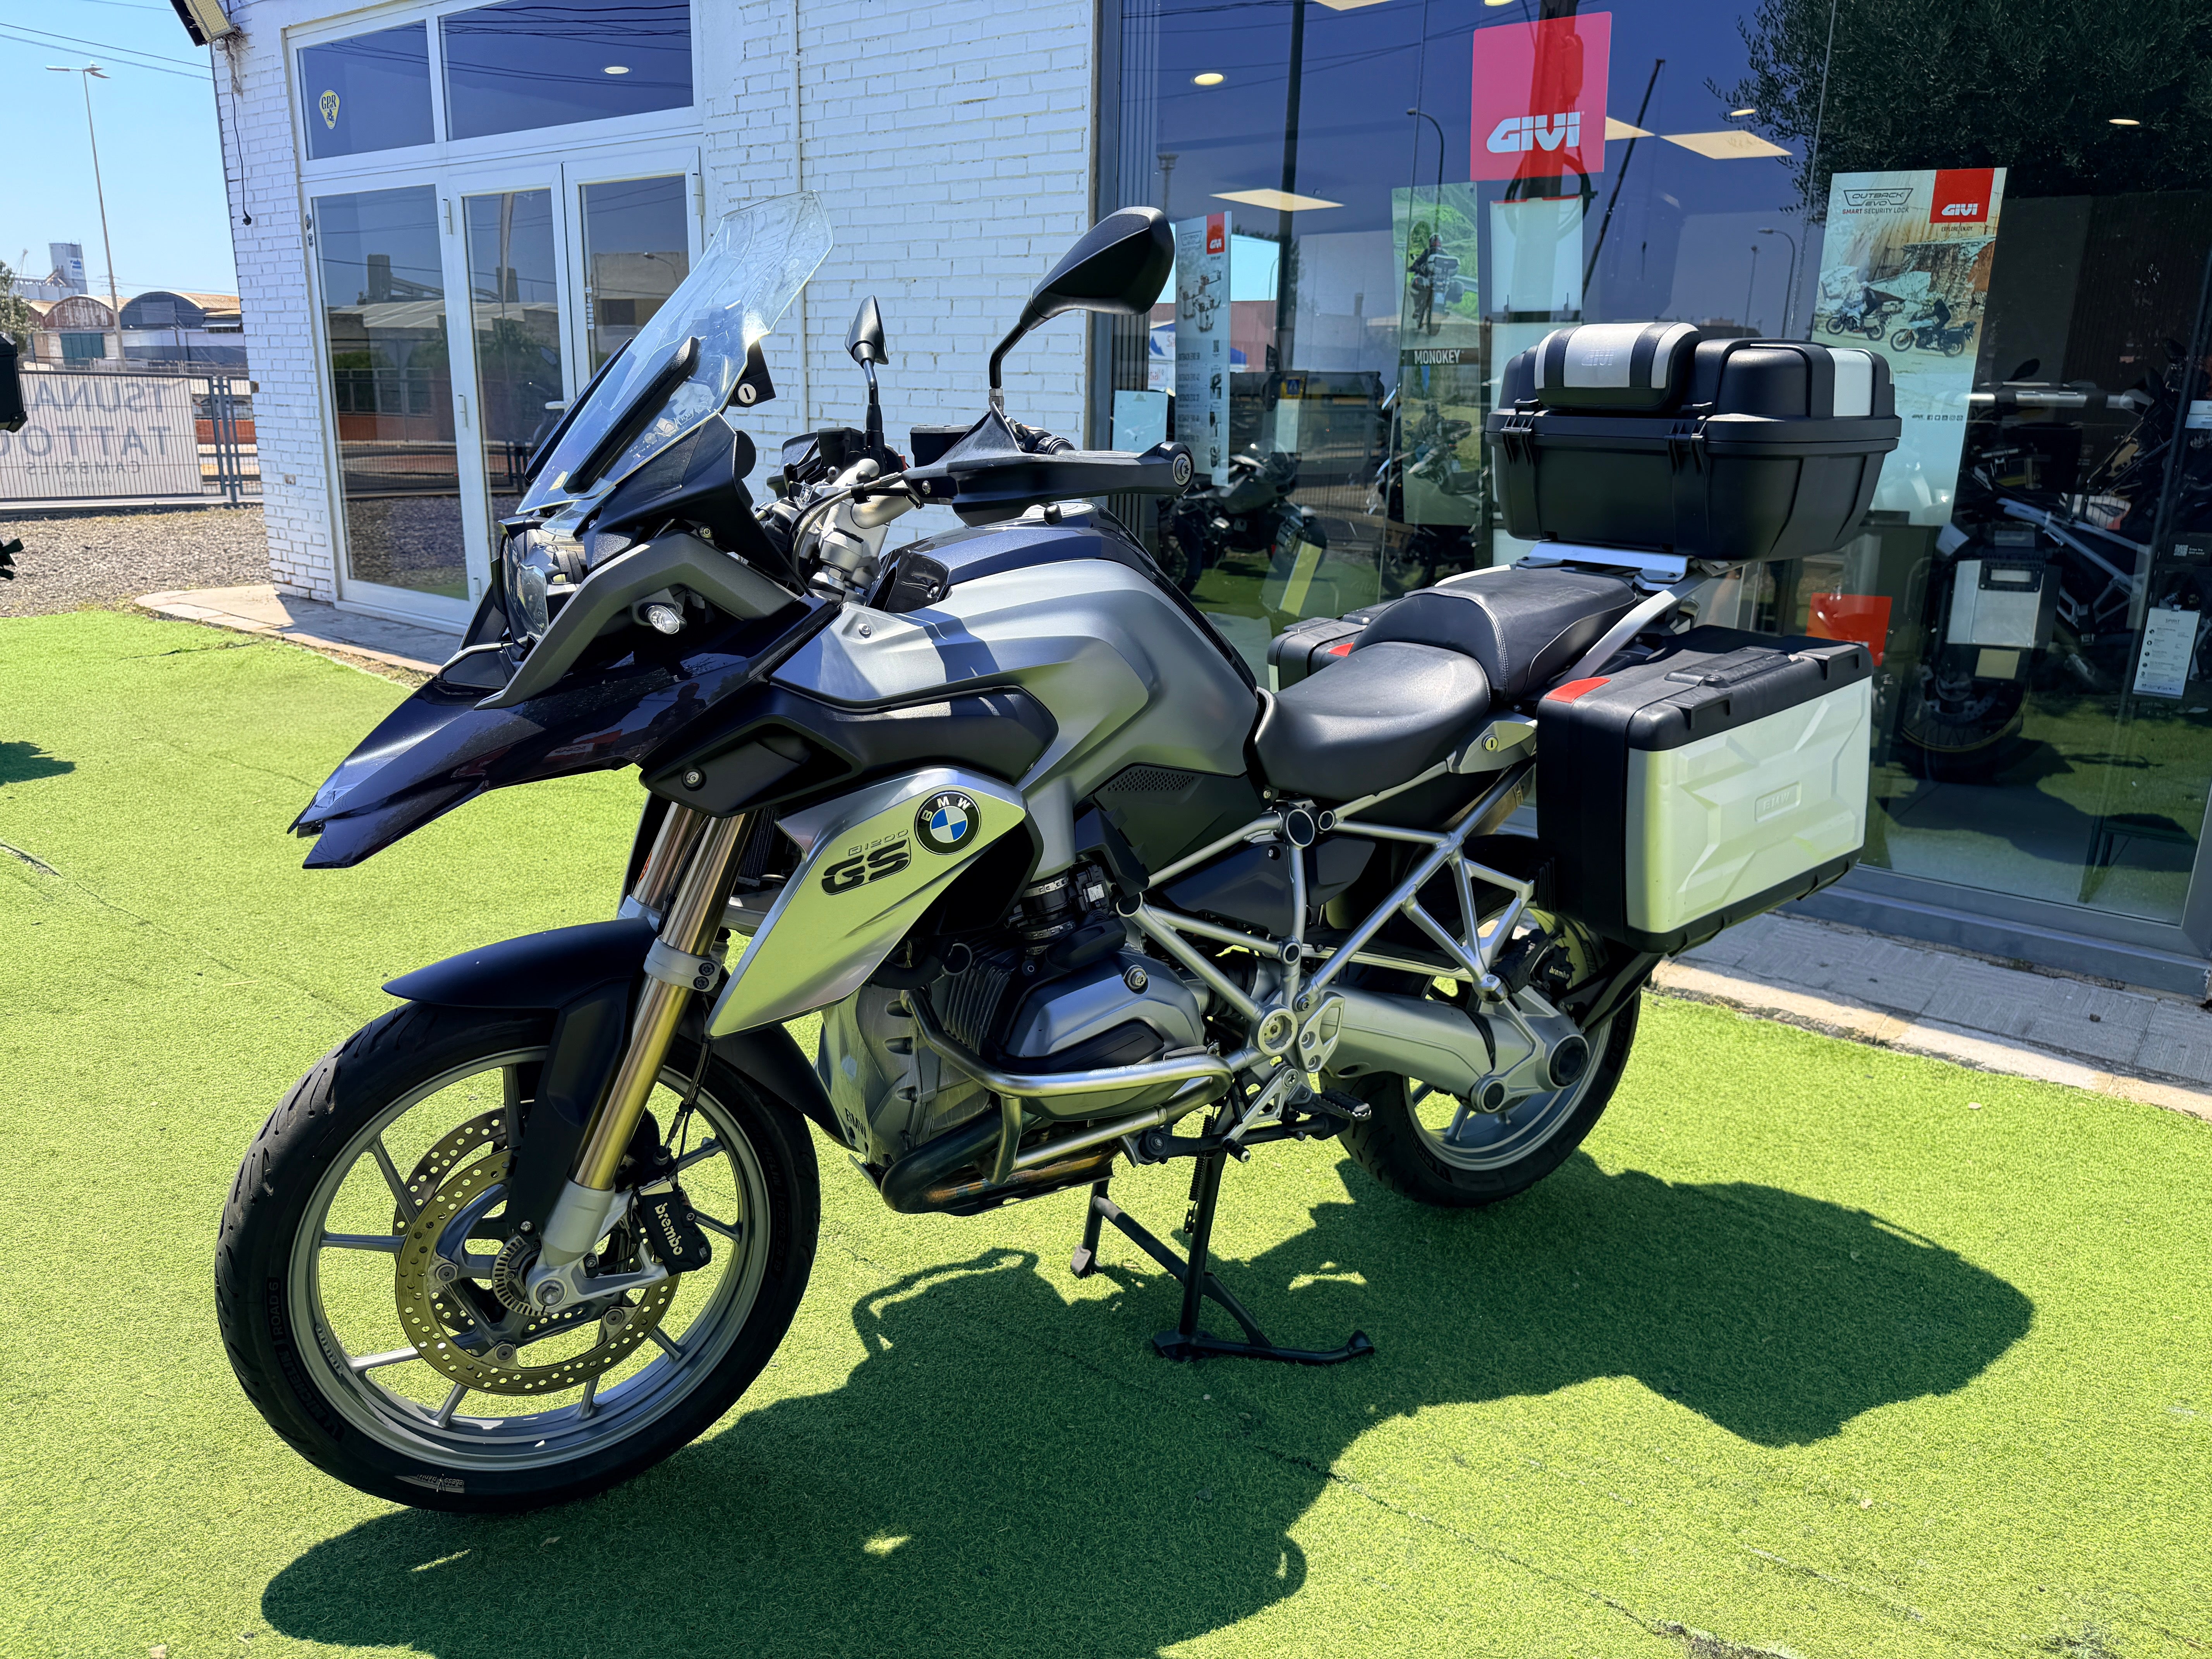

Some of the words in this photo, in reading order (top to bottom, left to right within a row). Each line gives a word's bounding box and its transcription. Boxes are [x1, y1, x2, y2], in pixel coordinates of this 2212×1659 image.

[321, 94, 336, 110] GPR
[1486, 112, 1581, 153] GIVI
[1941, 203, 1978, 216] GIVI
[1414, 349, 1460, 365] MONOKEY
[1581, 350, 1616, 366] GIVI
[921, 795, 971, 821] BMW
[1763, 792, 1790, 812] BMW
[847, 829, 909, 856] R1200
[821, 838, 910, 895] GS
[1549, 965, 1570, 980] brembo
[845, 1107, 867, 1139] BMW
[654, 1202, 684, 1256] brembo
[269, 1281, 279, 1291] 6
[270, 1297, 283, 1336] ROAD
[280, 1349, 328, 1422] MICHELIN
[444, 1478, 465, 1487] ELESS
